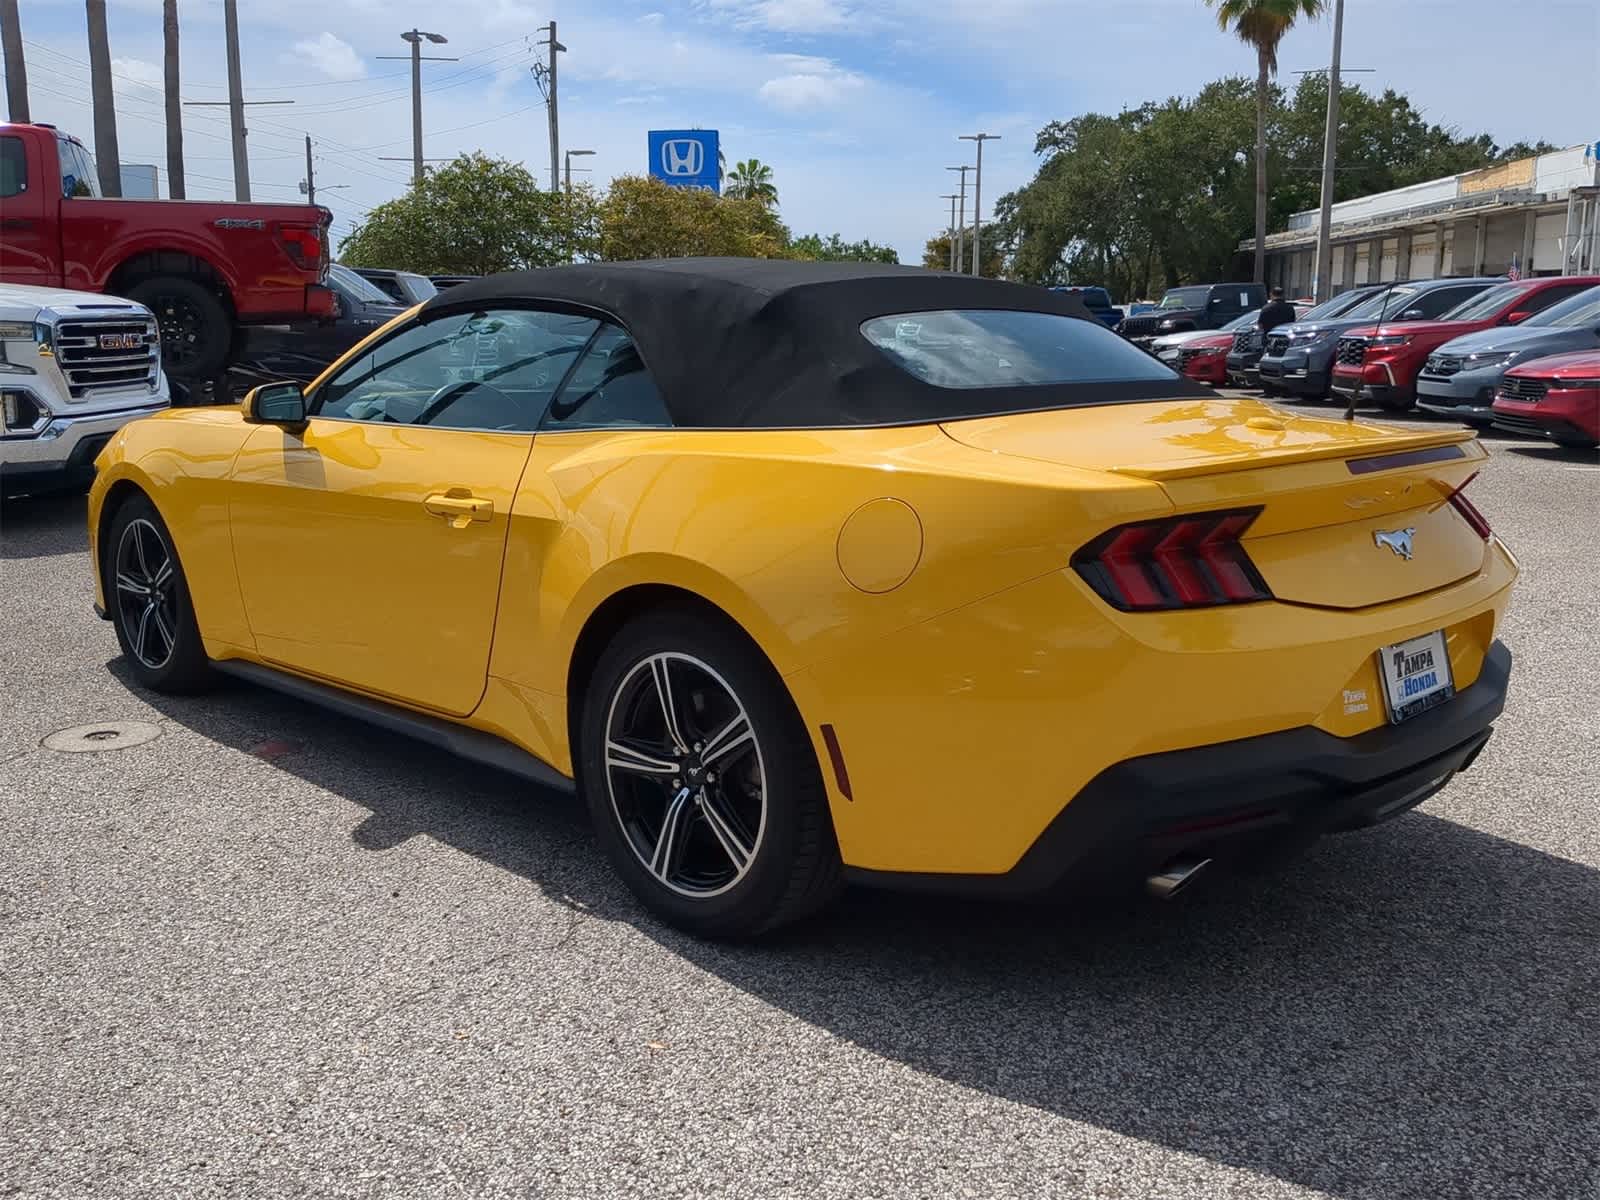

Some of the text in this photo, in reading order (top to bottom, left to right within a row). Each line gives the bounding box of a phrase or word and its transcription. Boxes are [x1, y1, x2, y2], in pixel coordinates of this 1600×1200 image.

[100, 333, 143, 350] GMC
[1393, 651, 1433, 677] TAMPA
[1404, 672, 1437, 696] HONDA
